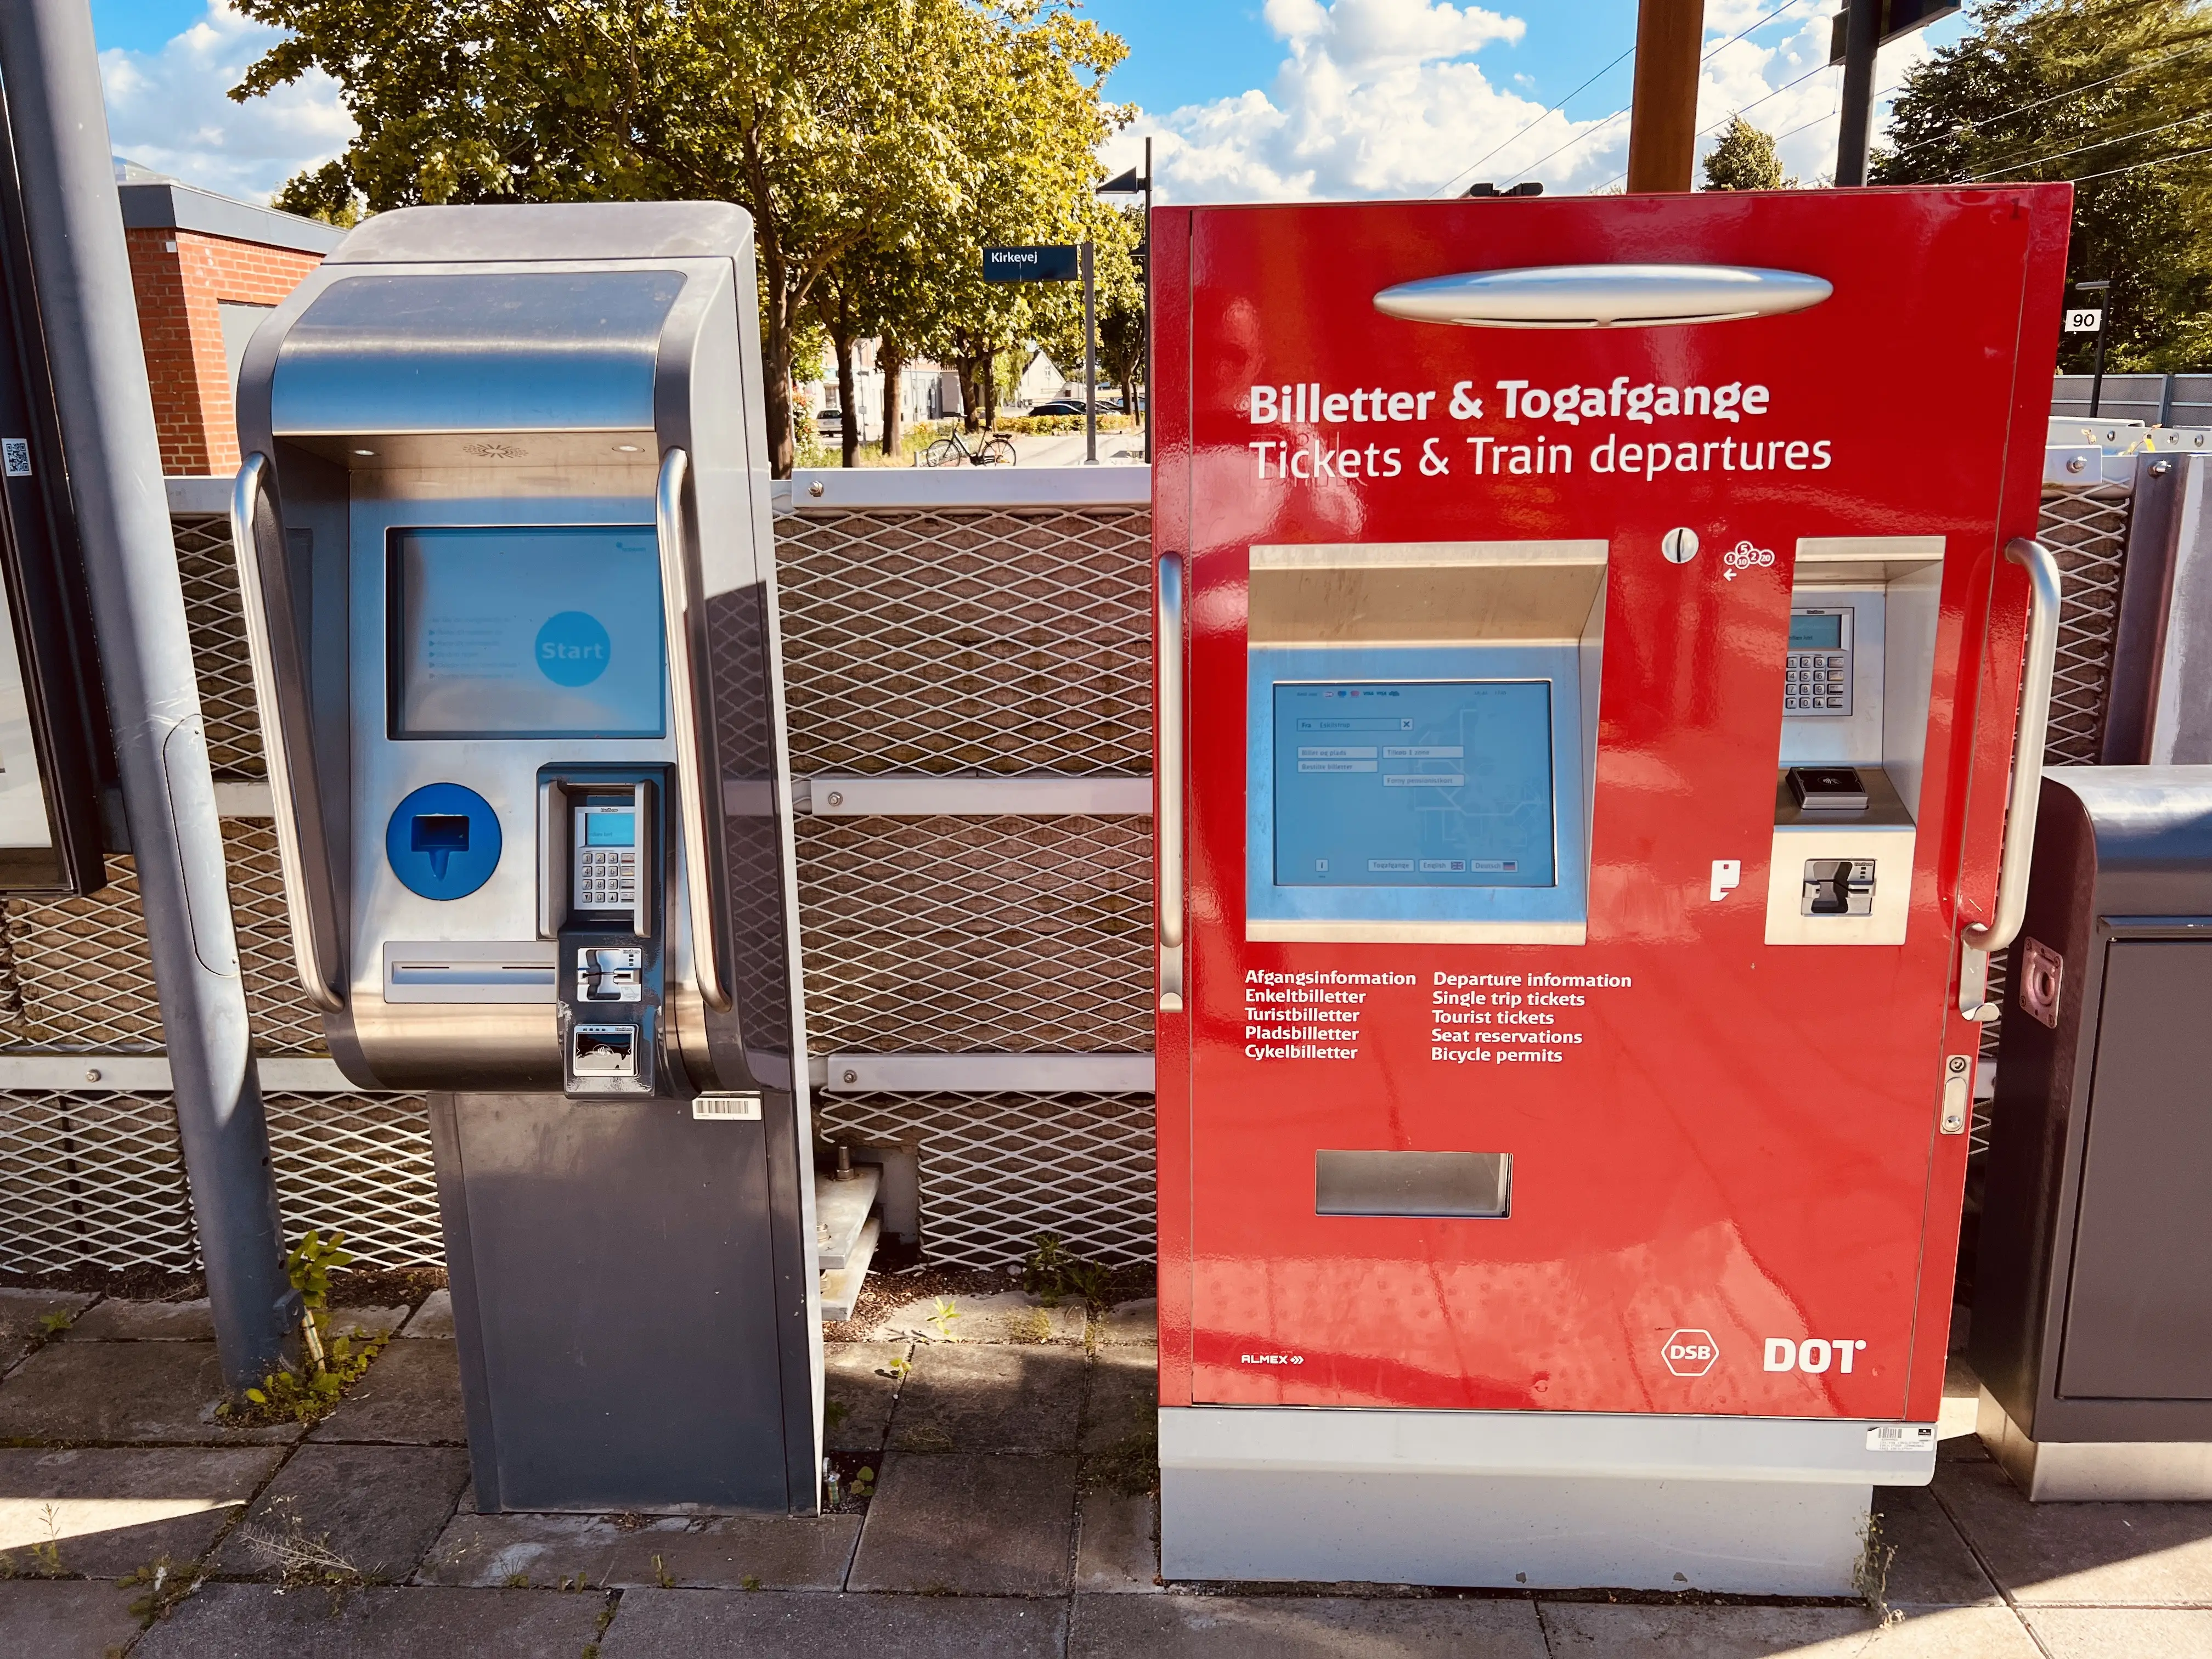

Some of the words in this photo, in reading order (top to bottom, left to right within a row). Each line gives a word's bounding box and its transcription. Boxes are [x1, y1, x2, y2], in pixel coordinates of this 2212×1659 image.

[991, 251, 1037, 264] Kirkevej
[2073, 314, 2094, 327] 90
[1251, 384, 1435, 423] Billetter
[1450, 382, 1482, 419] &
[1497, 377, 1769, 425] Togafgange
[1250, 440, 1401, 478] Tickets
[1420, 438, 1448, 476] &
[1468, 436, 1571, 474] Train
[1591, 434, 1831, 481] departures
[1740, 545, 1748, 555] 5
[541, 642, 603, 659] Start
[1329, 749, 1346, 758] plads
[1245, 969, 1416, 986] Afgangsinformation
[1434, 972, 1522, 989] Departure
[1528, 972, 1632, 988] information
[1246, 988, 1366, 1003] Enkeltbilletter
[1432, 991, 1486, 1007] Single
[1492, 992, 1521, 1008] trip
[1527, 991, 1585, 1006] tickets
[1245, 1007, 1360, 1022] Turistbilletter
[1432, 1009, 1492, 1024] Tourist
[1497, 1011, 1554, 1025] tickets
[1245, 1025, 1359, 1041] Pladsbilletter
[1432, 1029, 1470, 1042] Seat
[1476, 1030, 1583, 1044] reservations
[1245, 1044, 1358, 1061] Cykelbilletter
[1432, 1047, 1491, 1064] Bicycle
[1497, 1048, 1562, 1064] permits
[1241, 1355, 1288, 1364] ALMEX
[1670, 1345, 1711, 1359] DSB
[1764, 1338, 1854, 1374] DOT
